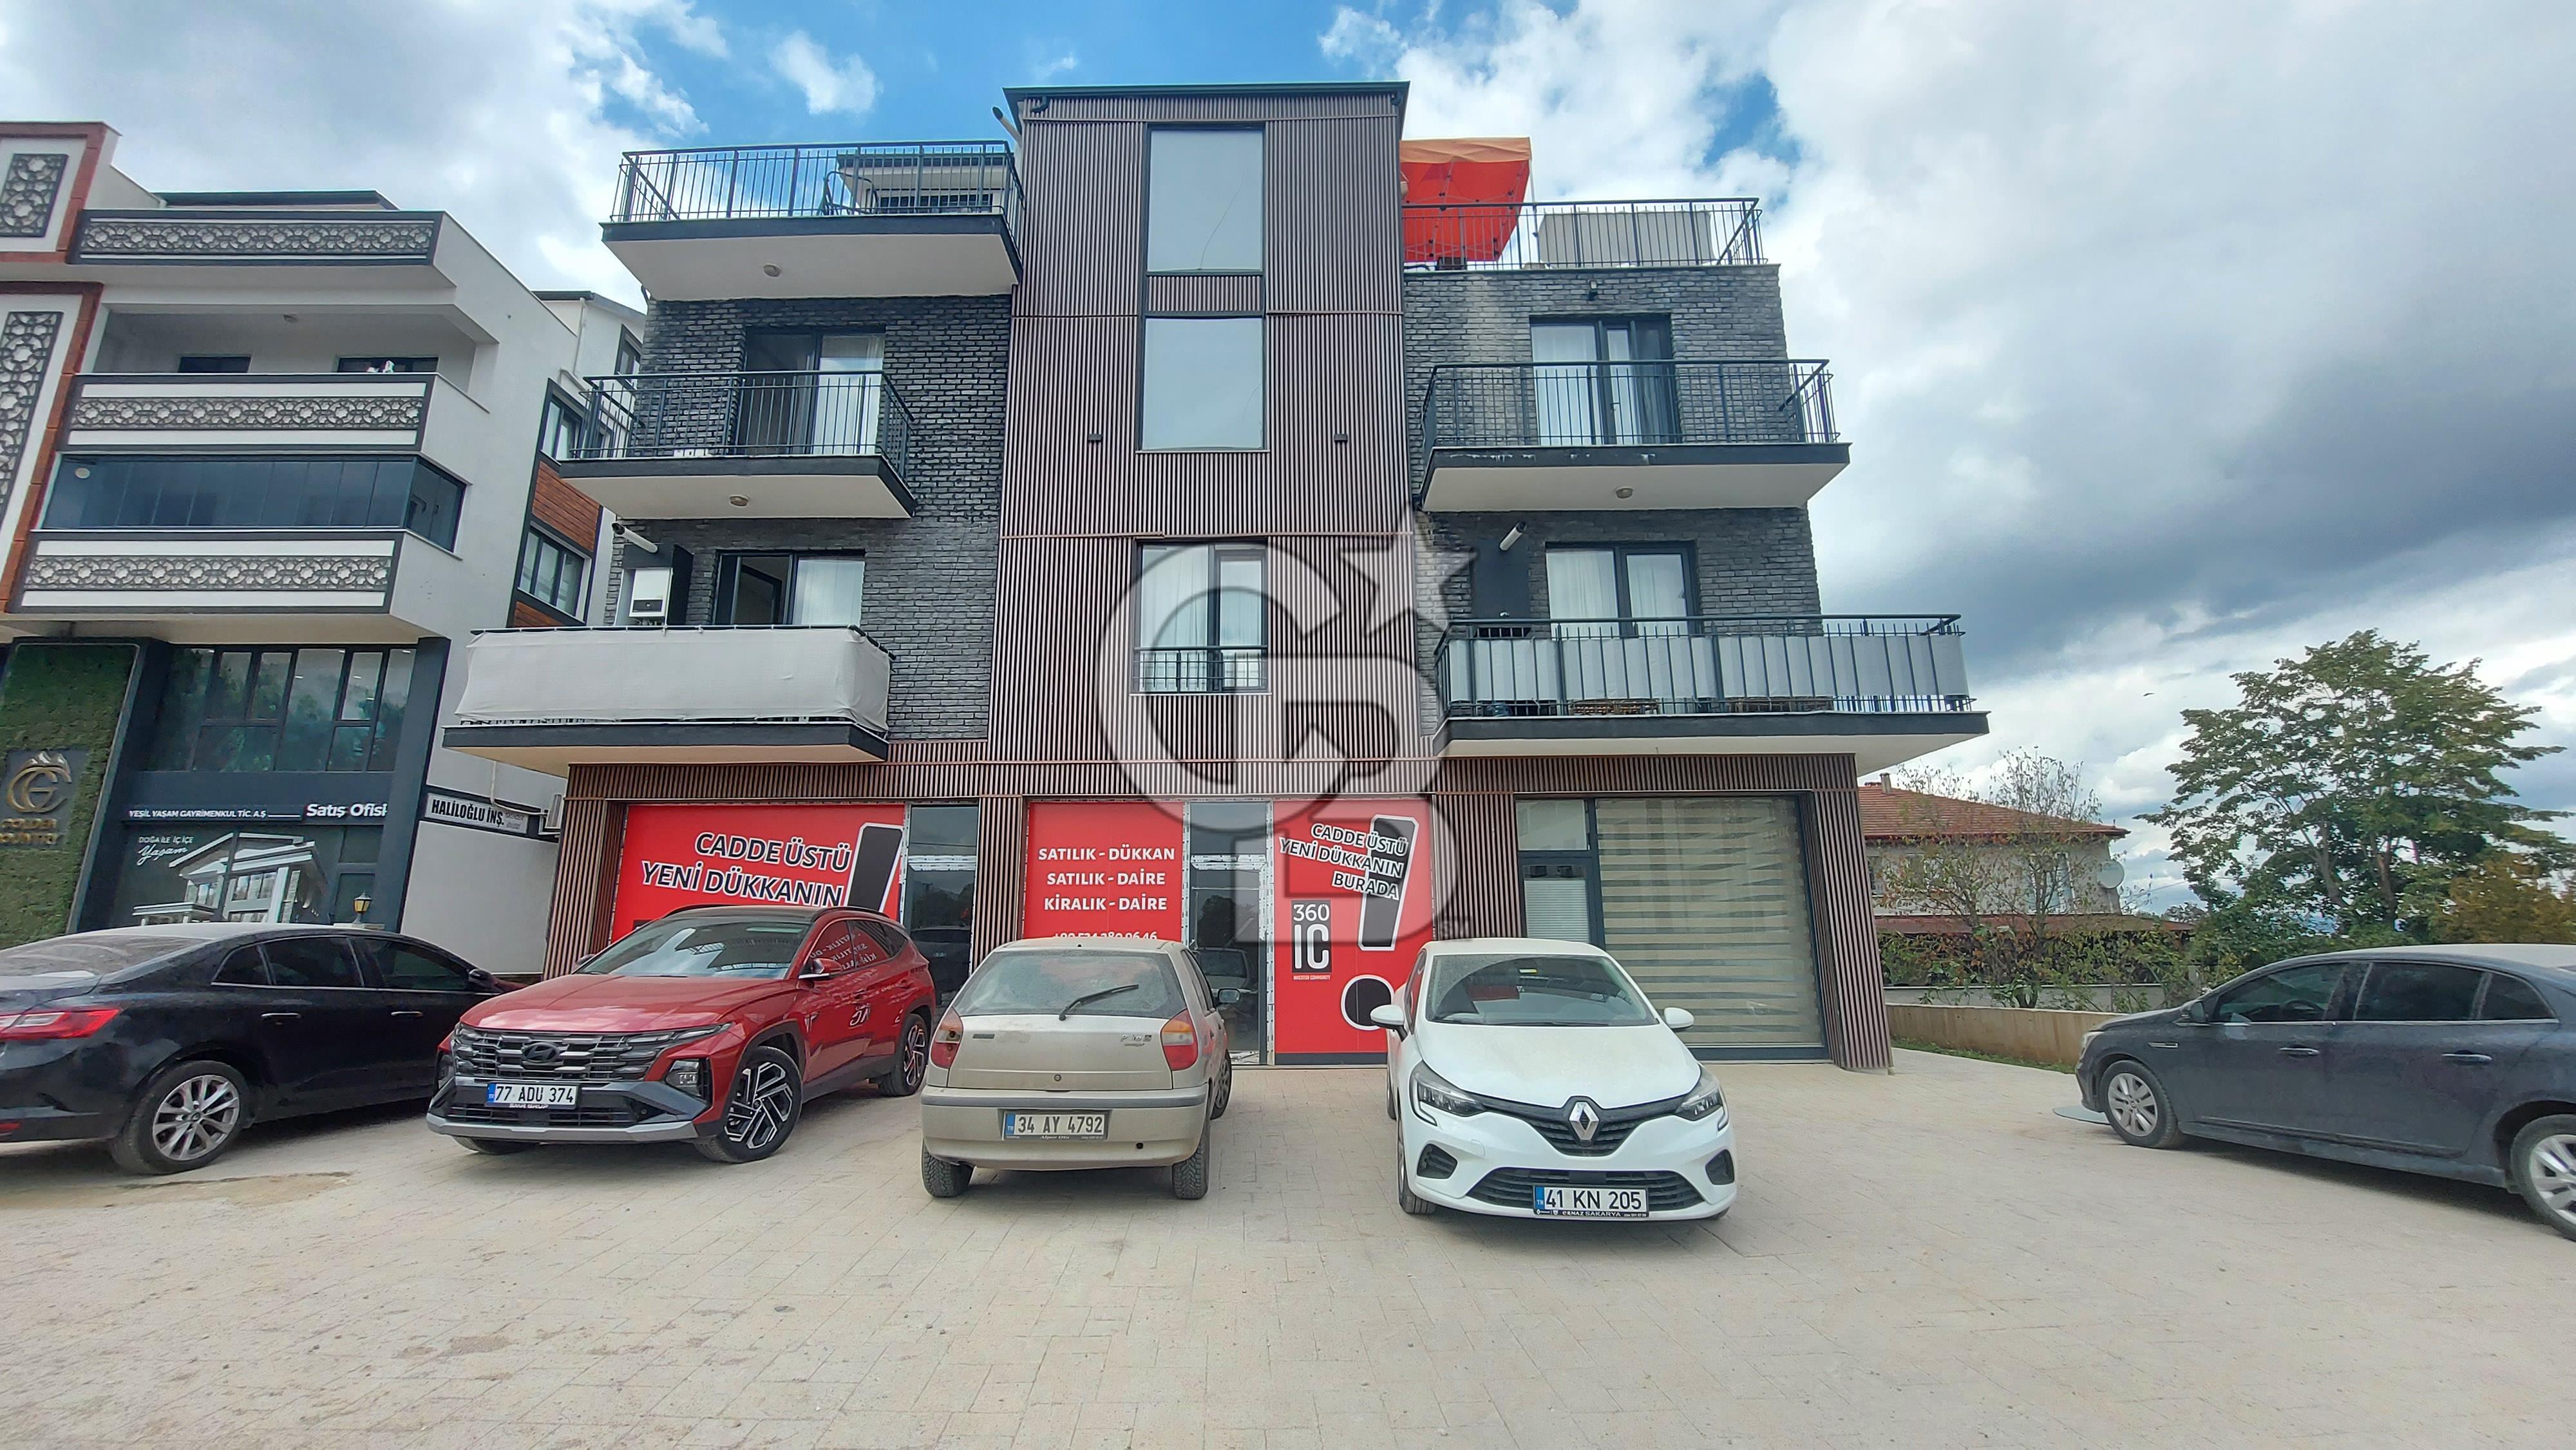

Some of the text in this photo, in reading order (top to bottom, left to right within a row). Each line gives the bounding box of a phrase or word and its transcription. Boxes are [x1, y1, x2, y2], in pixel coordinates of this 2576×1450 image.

[306, 804, 346, 818] Satış
[431, 799, 486, 822] HALİLOĞLU
[1311, 823, 1408, 856] CADDE ÜSTÜ
[696, 832, 852, 872] CADDE ÜSTÜ
[1038, 848, 1096, 860] SATILIK
[1108, 844, 1175, 860] DÜKKAN
[1279, 836, 1404, 878] YENİ DÜKKANIN
[641, 860, 845, 907] YENİ DÜKKANIN
[1046, 872, 1105, 885] SATILIK
[1117, 868, 1166, 885] DAİRE
[1332, 871, 1399, 901] BURADA
[1044, 894, 1106, 910] KİRALIK
[1119, 893, 1167, 910] DAİRE
[1293, 903, 1330, 921] 360
[1294, 923, 1329, 969] IC
[496, 1086, 573, 1102] 77 ADU 374
[1018, 1116, 1103, 1133] 34 AY 4792
[1546, 1190, 1642, 1209] 41 KN 205
